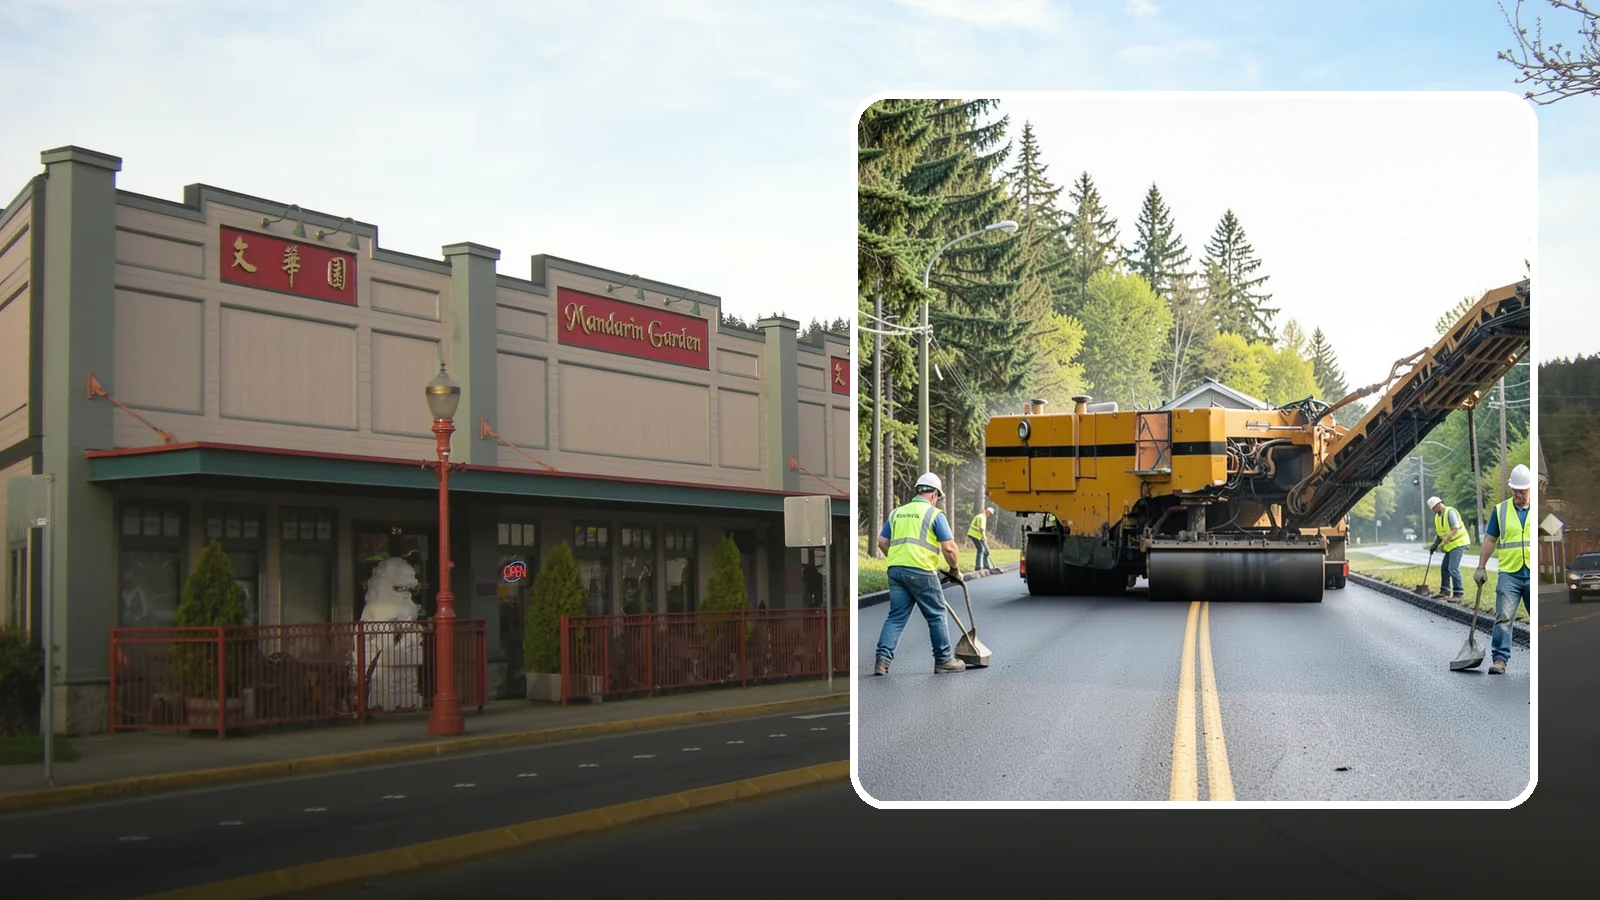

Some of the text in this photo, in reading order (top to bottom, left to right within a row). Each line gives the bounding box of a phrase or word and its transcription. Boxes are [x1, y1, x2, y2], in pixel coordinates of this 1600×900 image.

[231, 236, 346, 290] 文華園
[565, 302, 701, 352] Mandarin Garden
[835, 363, 846, 386] 文
[503, 565, 527, 578] OPEN
